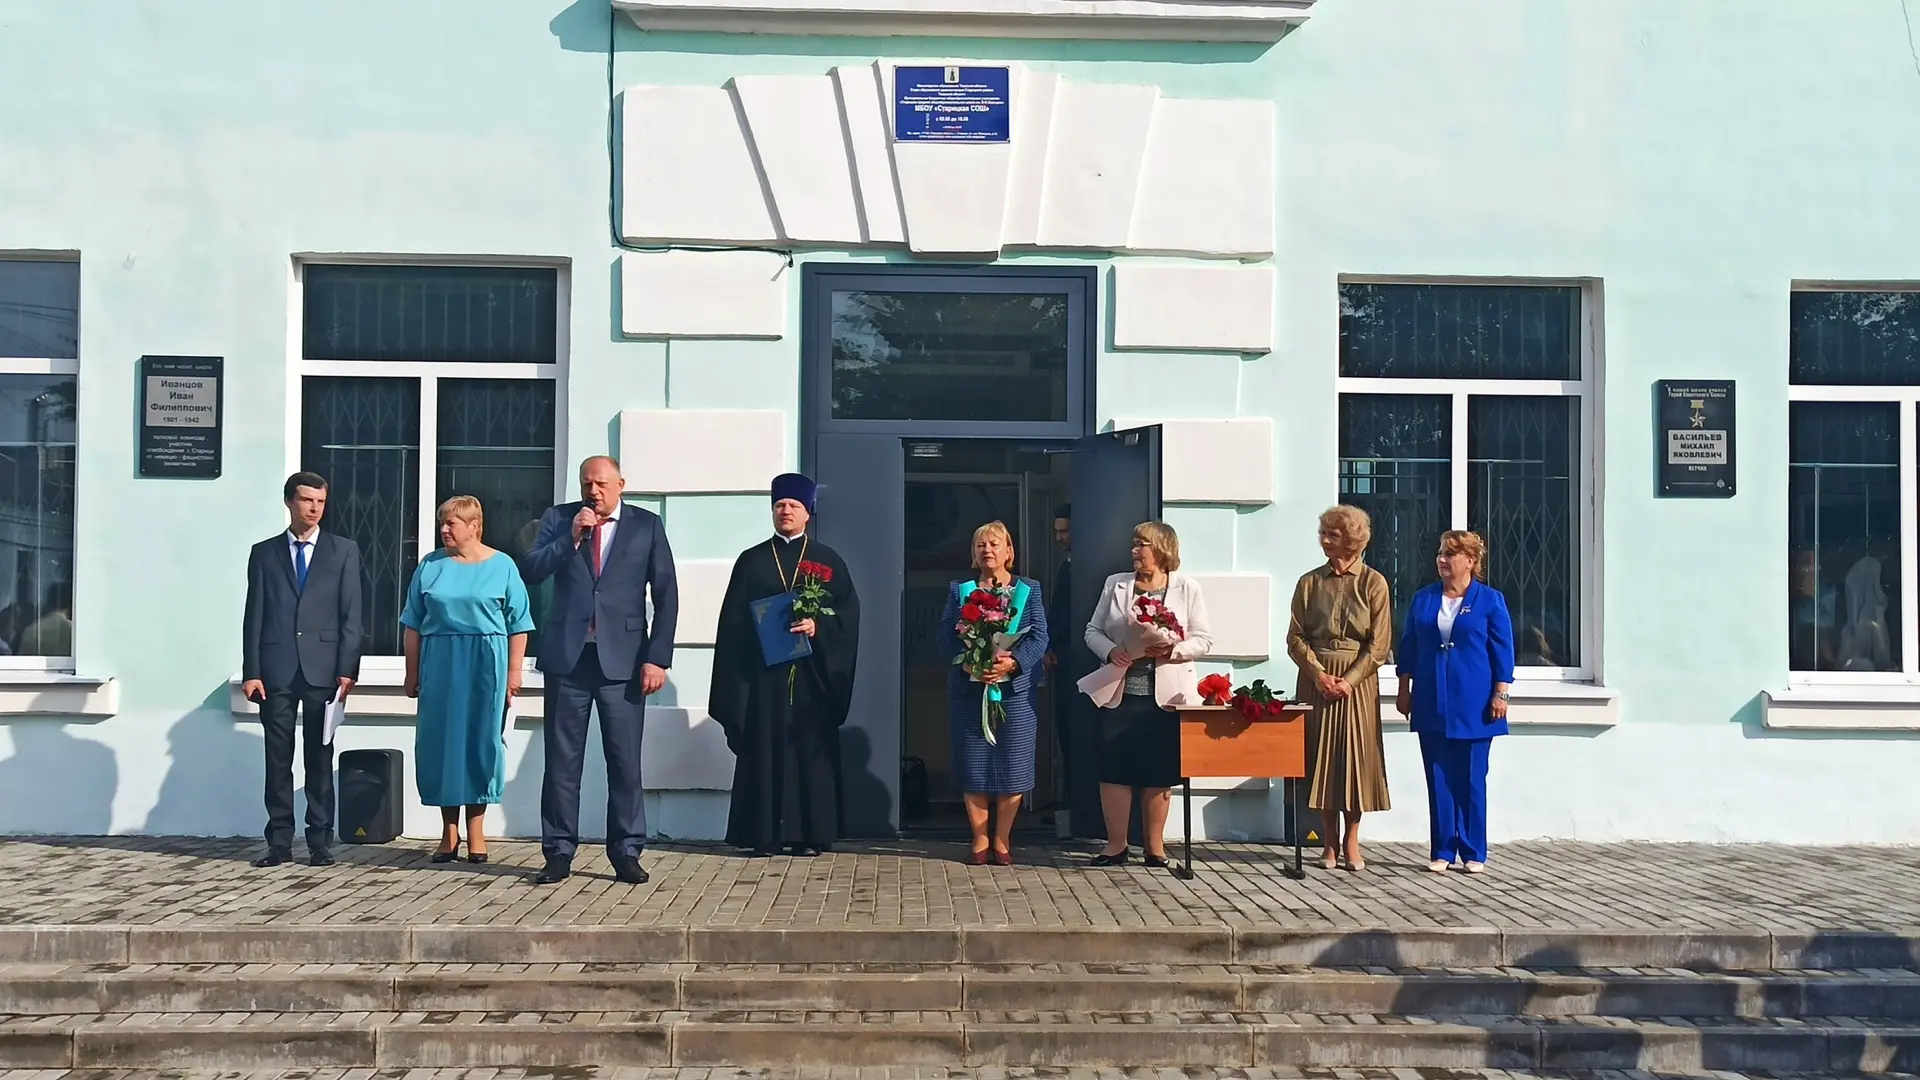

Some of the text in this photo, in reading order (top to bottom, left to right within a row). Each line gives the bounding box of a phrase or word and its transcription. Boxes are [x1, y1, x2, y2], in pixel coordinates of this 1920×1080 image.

[160, 379, 203, 389] Иванцов
[169, 391, 194, 400] Иван
[150, 403, 212, 412] Филиппович
[1673, 433, 1722, 441] ВАСИЛЬЕВ
